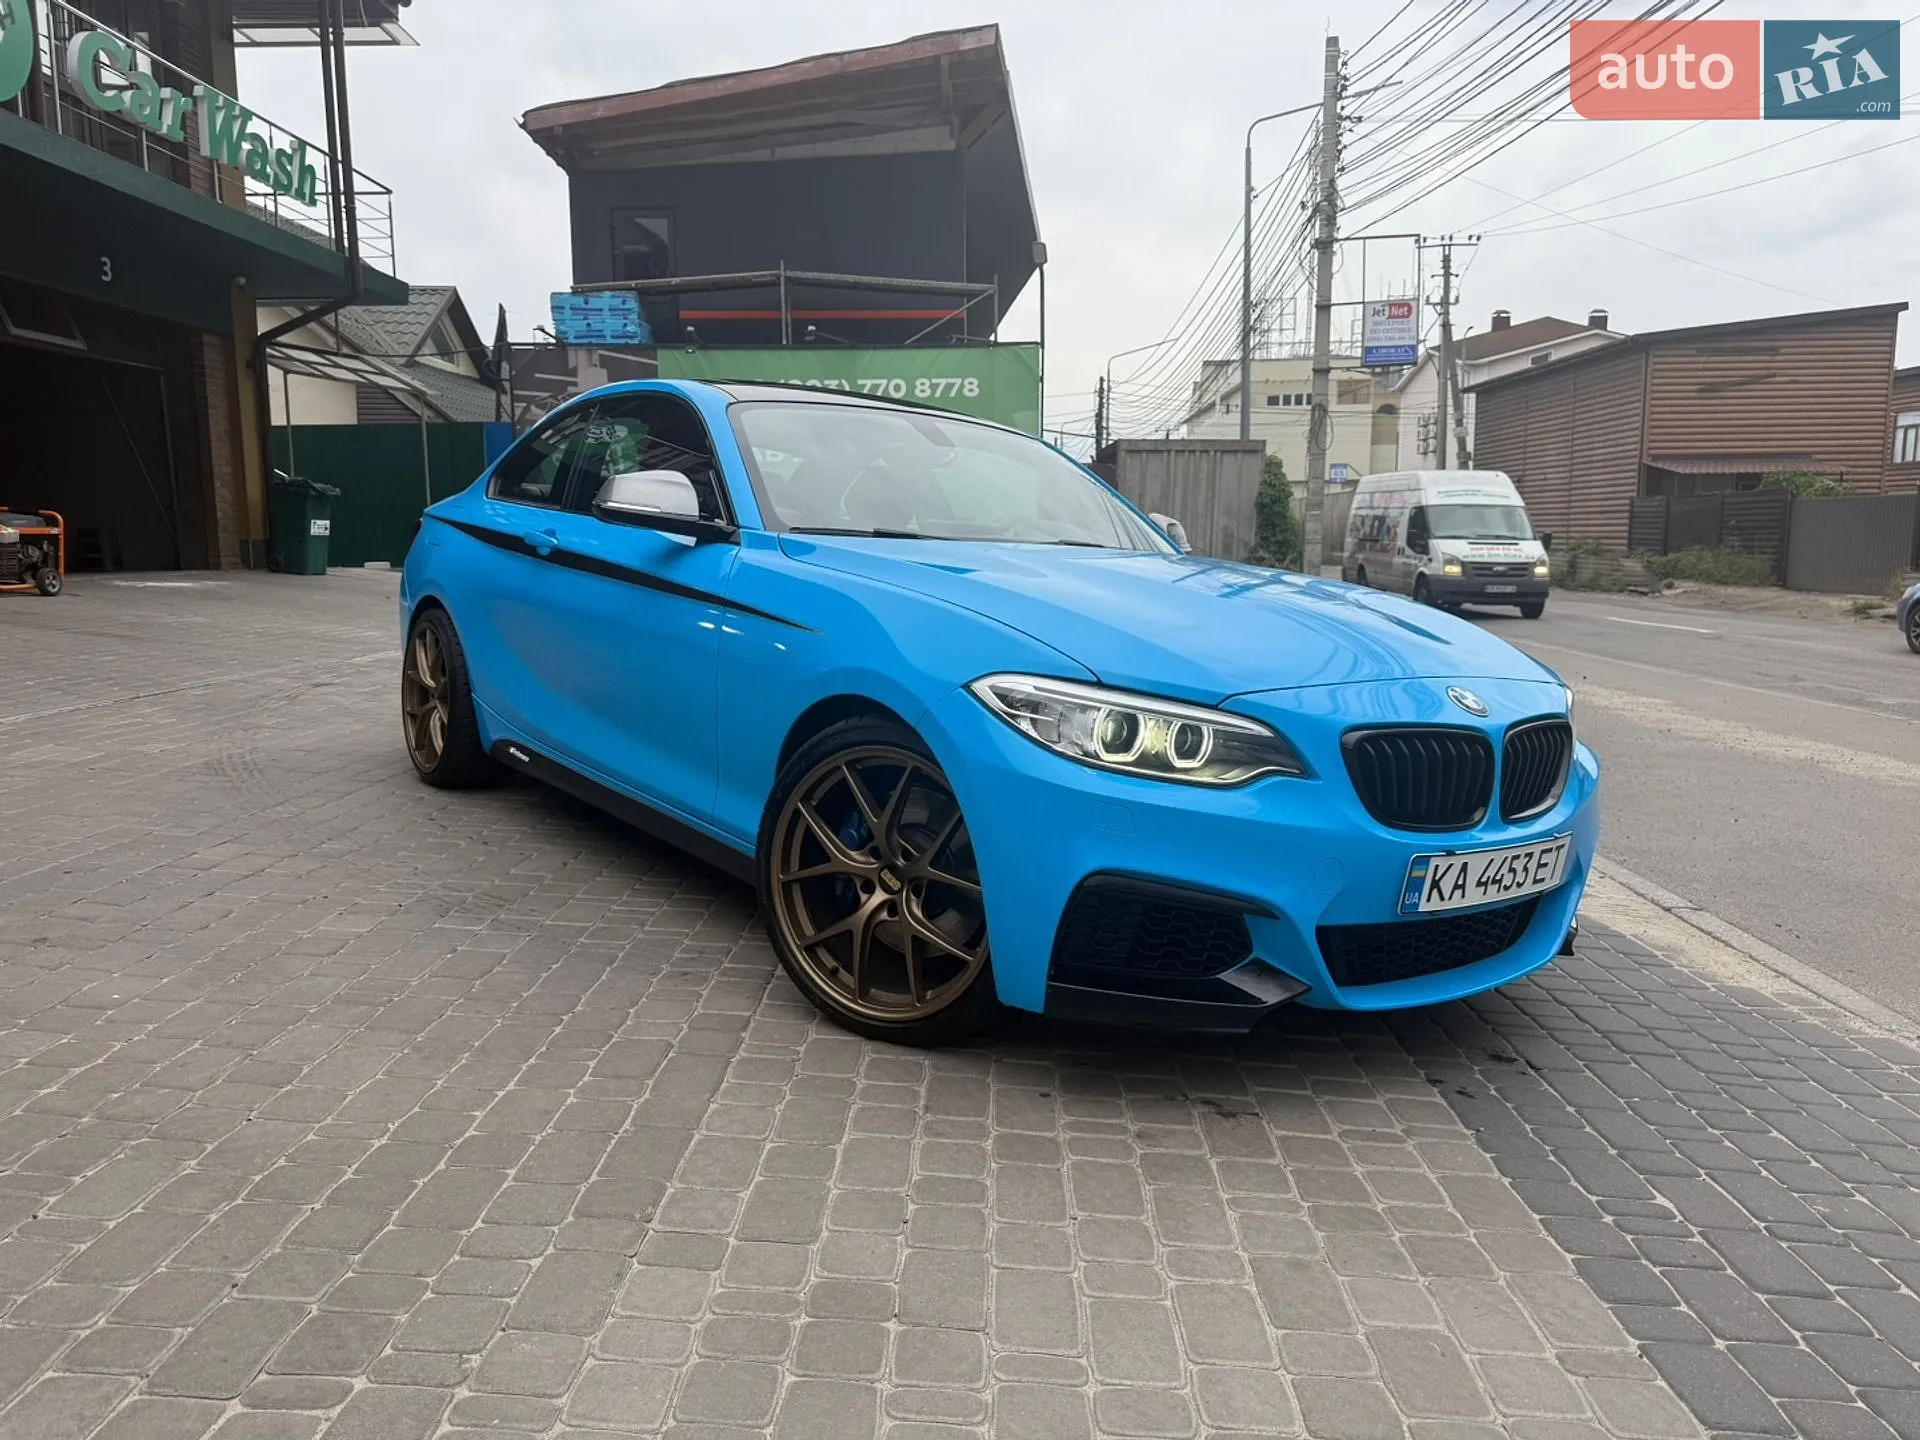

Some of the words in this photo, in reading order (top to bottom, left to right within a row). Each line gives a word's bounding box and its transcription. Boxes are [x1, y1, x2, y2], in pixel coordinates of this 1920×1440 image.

[66, 29, 193, 143] Car
[192, 85, 318, 208] Wash
[99, 256, 113, 283] 3
[914, 377, 980, 398] 8778
[1426, 861, 1470, 903] KA
[1475, 851, 1533, 895] 4453
[1532, 844, 1565, 885] ET
[1405, 891, 1420, 905] UA
